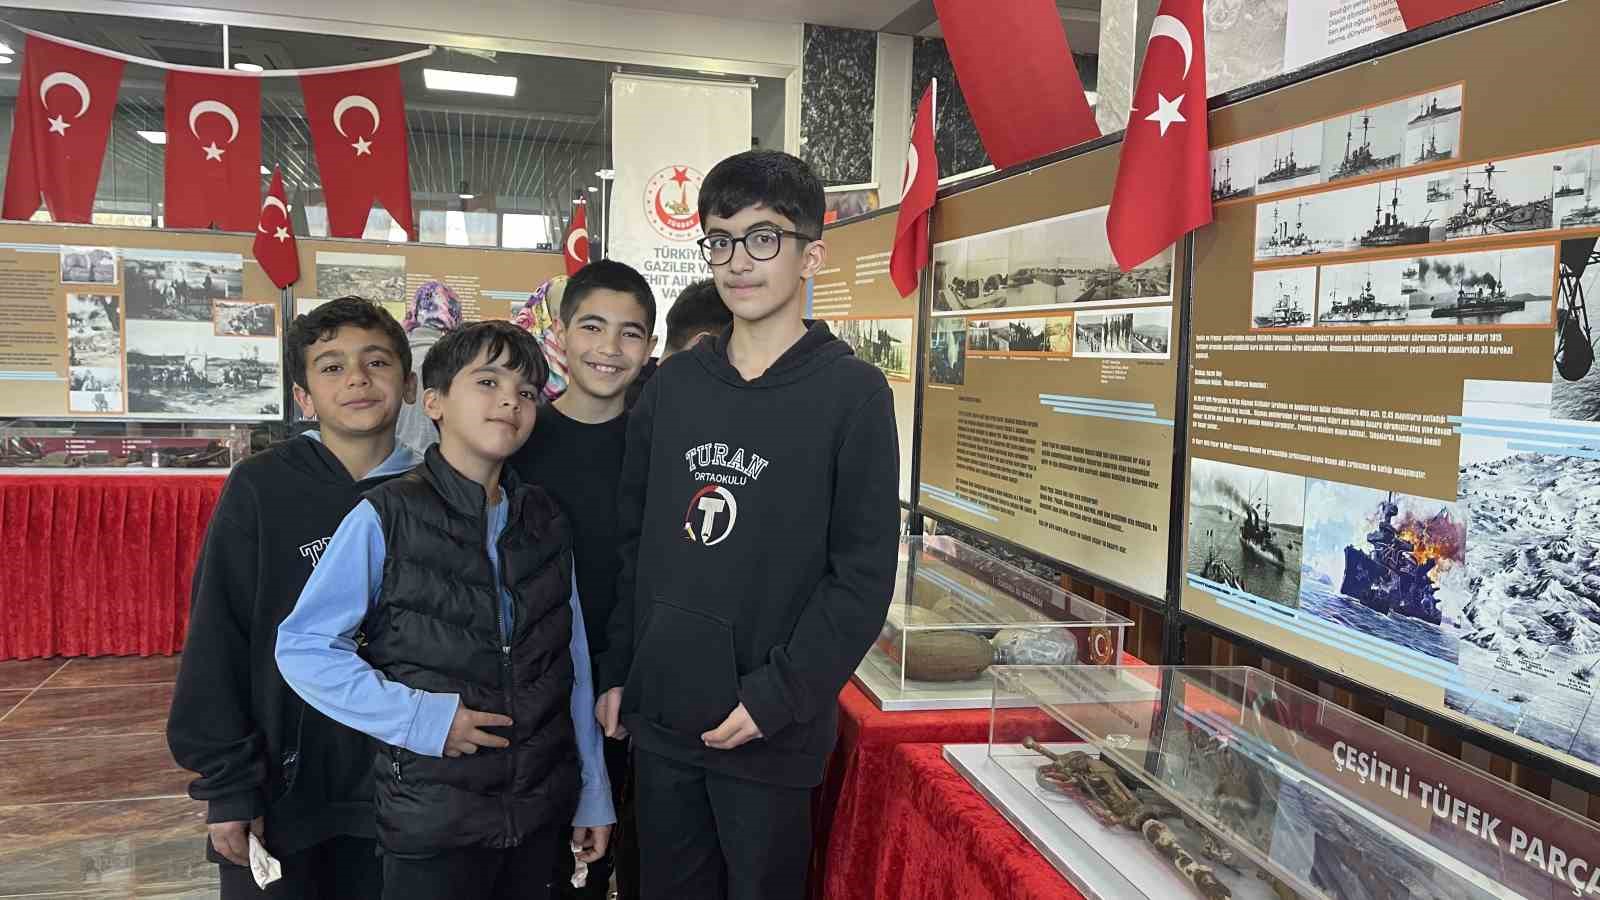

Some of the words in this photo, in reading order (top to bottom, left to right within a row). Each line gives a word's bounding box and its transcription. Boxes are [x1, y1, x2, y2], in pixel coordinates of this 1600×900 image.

[685, 443, 769, 480] TURAN
[694, 472, 747, 485] ORTAOKULU
[1332, 741, 1411, 799] ÇEŞİTLİ
[1418, 781, 1503, 847] TÜFEK
